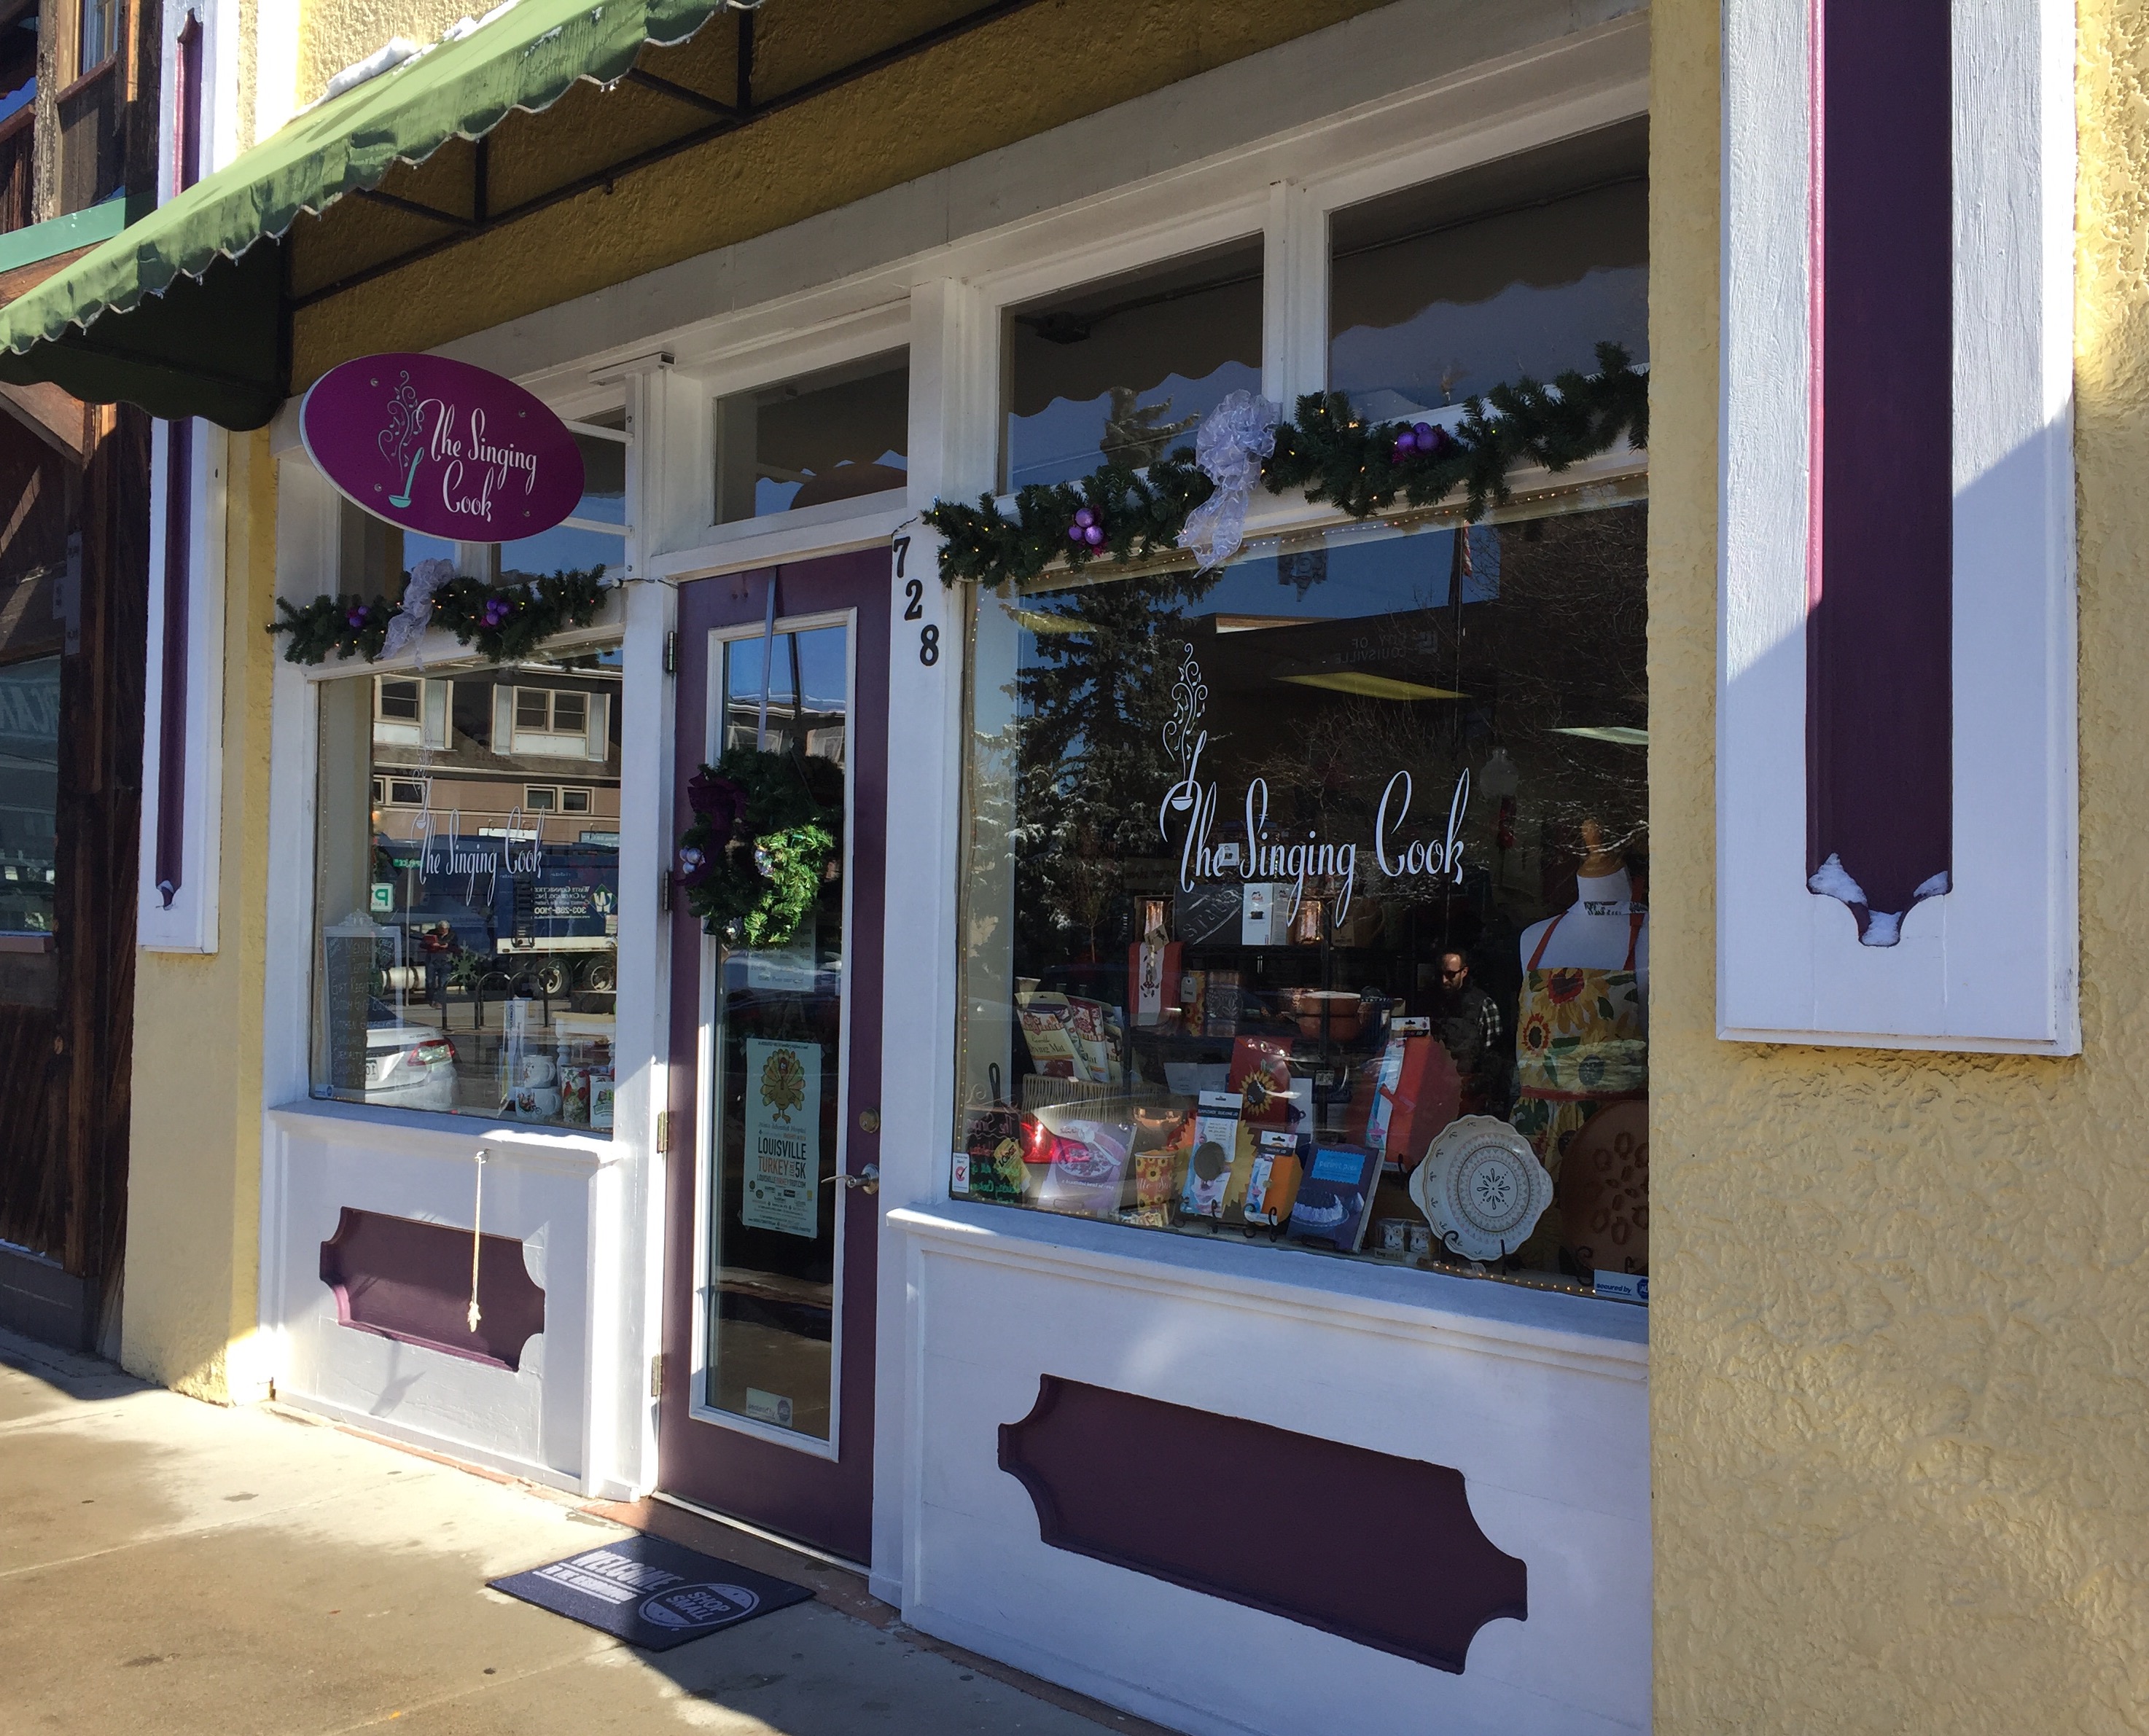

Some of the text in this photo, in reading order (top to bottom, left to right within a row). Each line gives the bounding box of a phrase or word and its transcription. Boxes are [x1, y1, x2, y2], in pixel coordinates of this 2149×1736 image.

[416, 398, 537, 496] The Singing
[442, 459, 492, 523] Cook
[410, 805, 545, 906] The Singing Cook
[1160, 767, 1470, 928] The Singing Cook
[758, 1136, 806, 1160] LOUISVILLE
[758, 1155, 789, 1176] TURKEY
[795, 1161, 806, 1179] 5K
[1596, 1283, 1623, 1291] secured
[1624, 1286, 1632, 1294] by
[572, 1550, 685, 1591] WELCOME
[666, 1595, 714, 1621] SMALL
[687, 1591, 731, 1612] SHOP
